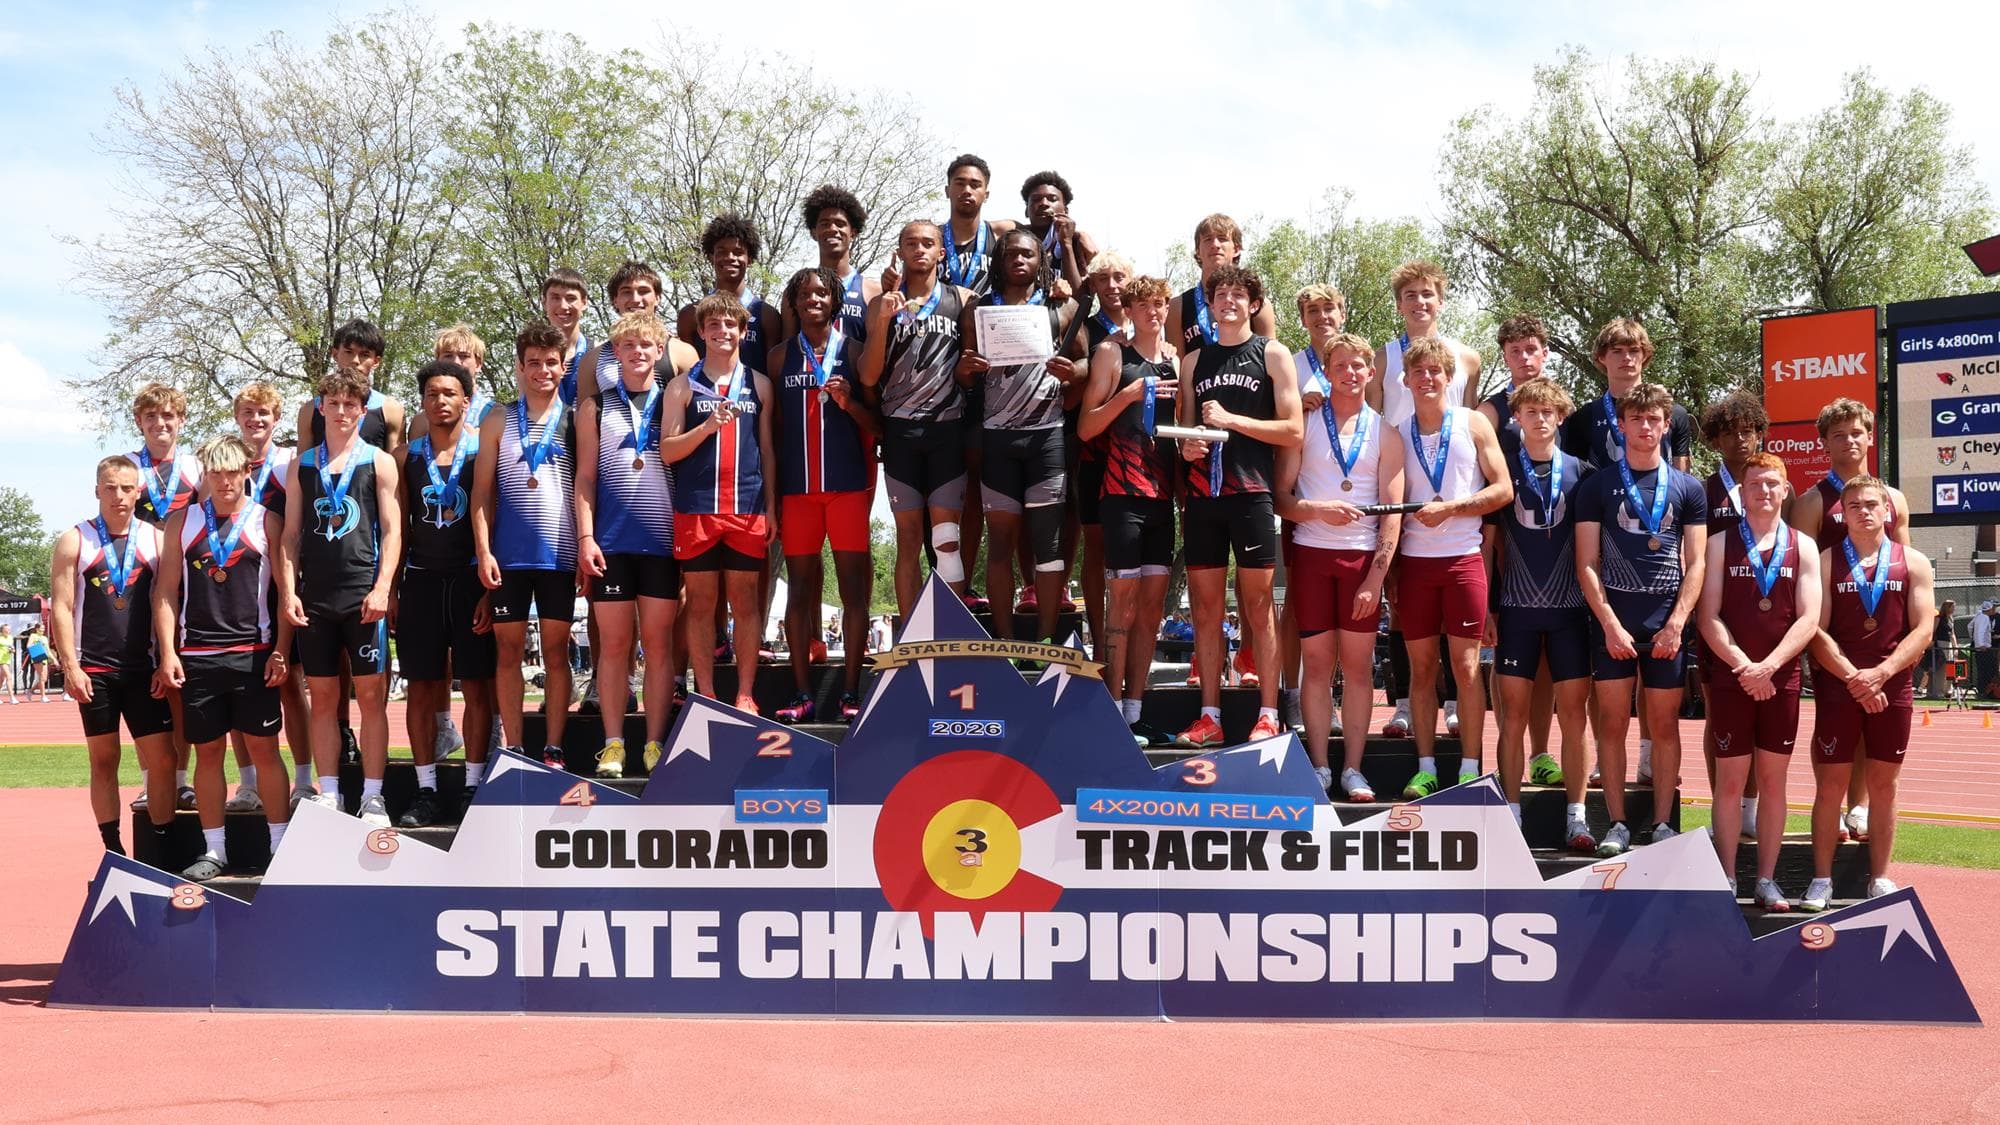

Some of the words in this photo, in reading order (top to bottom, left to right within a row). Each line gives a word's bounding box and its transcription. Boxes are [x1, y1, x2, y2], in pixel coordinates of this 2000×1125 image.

[841, 304, 862, 317] NVER
[1901, 338, 1933, 352] Girls
[1936, 333, 1993, 348] 4x800m
[785, 374, 808, 388] KENT
[1195, 373, 1260, 397] STRASBURG
[1961, 384, 1970, 393] A
[696, 400, 720, 413] KENT
[1962, 401, 2000, 415] Gran
[1961, 422, 1970, 432] A
[1767, 440, 1784, 453] CO
[1787, 439, 1814, 453] Prep
[1963, 440, 2000, 455] Chey
[1962, 461, 1970, 470] A
[1963, 479, 2000, 492] Kiow
[1962, 500, 1971, 510] A
[898, 642, 960, 656] STATE
[967, 643, 1076, 661] CHAMPION
[949, 683, 976, 711] 1
[931, 722, 1002, 736] 2026
[756, 730, 793, 758] 2
[1182, 759, 1218, 786] 3
[559, 782, 597, 807] 4
[742, 798, 823, 815] BOYS
[1088, 799, 1200, 817] 4X200M
[1210, 802, 1308, 821] RELAY
[1387, 804, 1423, 831] 5
[366, 829, 399, 854] 6
[535, 829, 829, 869] COLORADO
[955, 828, 988, 853] 3
[1076, 830, 1269, 871] TRACK
[1280, 830, 1320, 871] &
[1330, 830, 1479, 871] FIELD
[1592, 862, 1627, 891] 7
[172, 884, 206, 910] 8
[436, 909, 721, 978] STATE
[738, 911, 1558, 982] CHAMPIONSHIPS
[1800, 922, 1837, 951] 9
